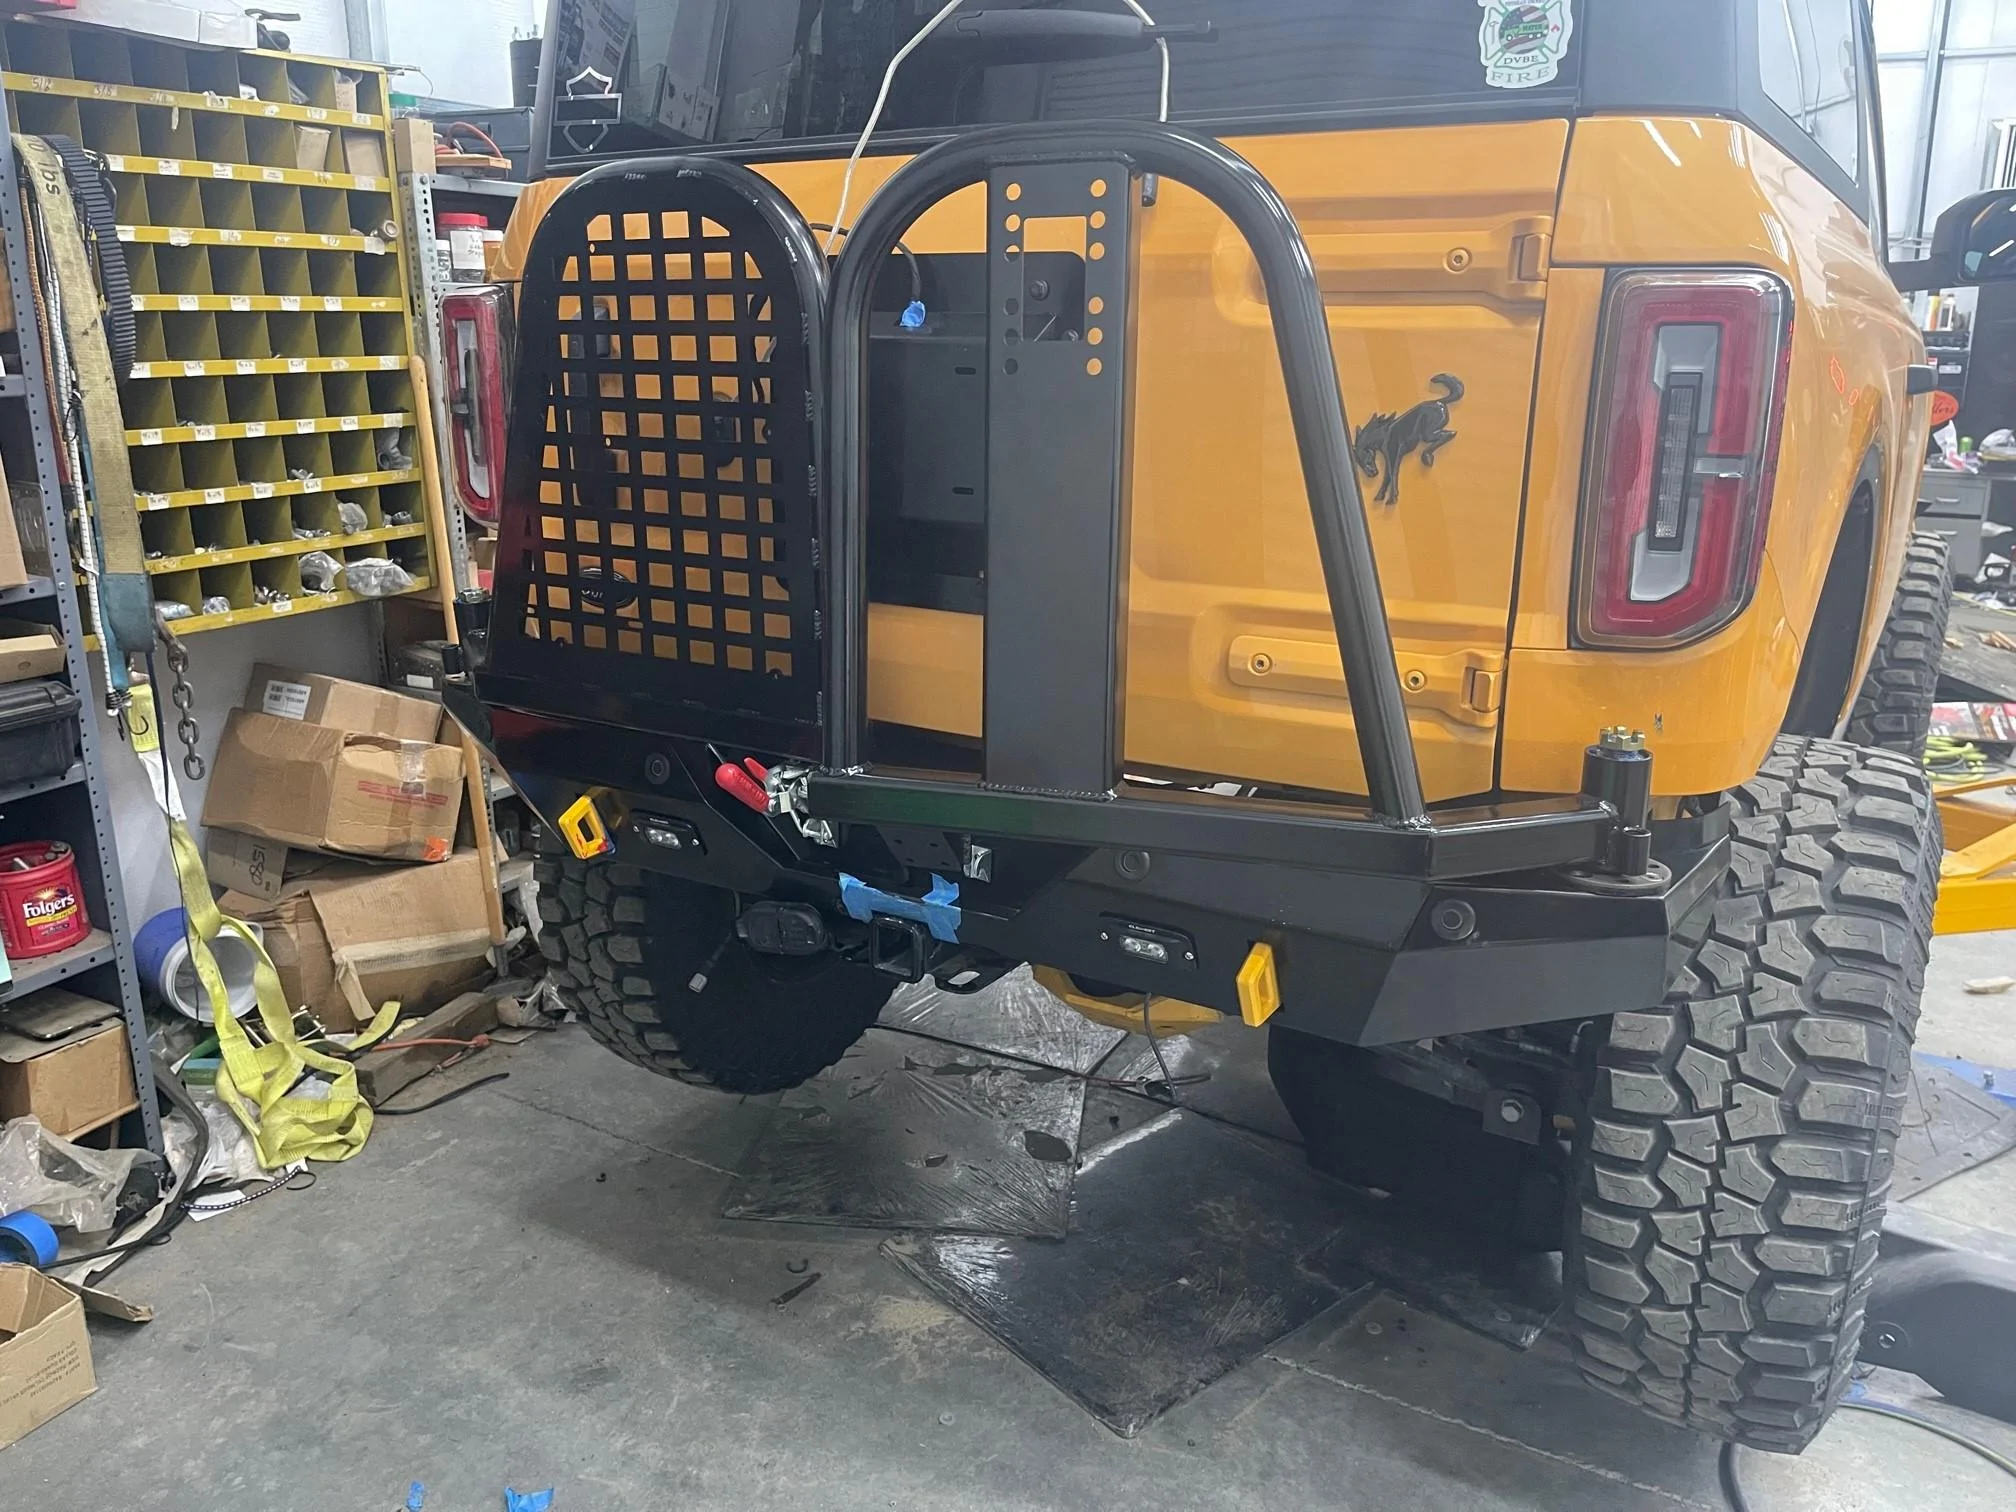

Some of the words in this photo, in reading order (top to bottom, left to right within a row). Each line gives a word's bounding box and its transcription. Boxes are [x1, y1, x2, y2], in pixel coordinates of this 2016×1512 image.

[1503, 55, 1538, 65] DVBE
[1491, 66, 1550, 83] FIRE
[37, 161, 60, 195] lbs
[22, 894, 75, 918] Folgers
